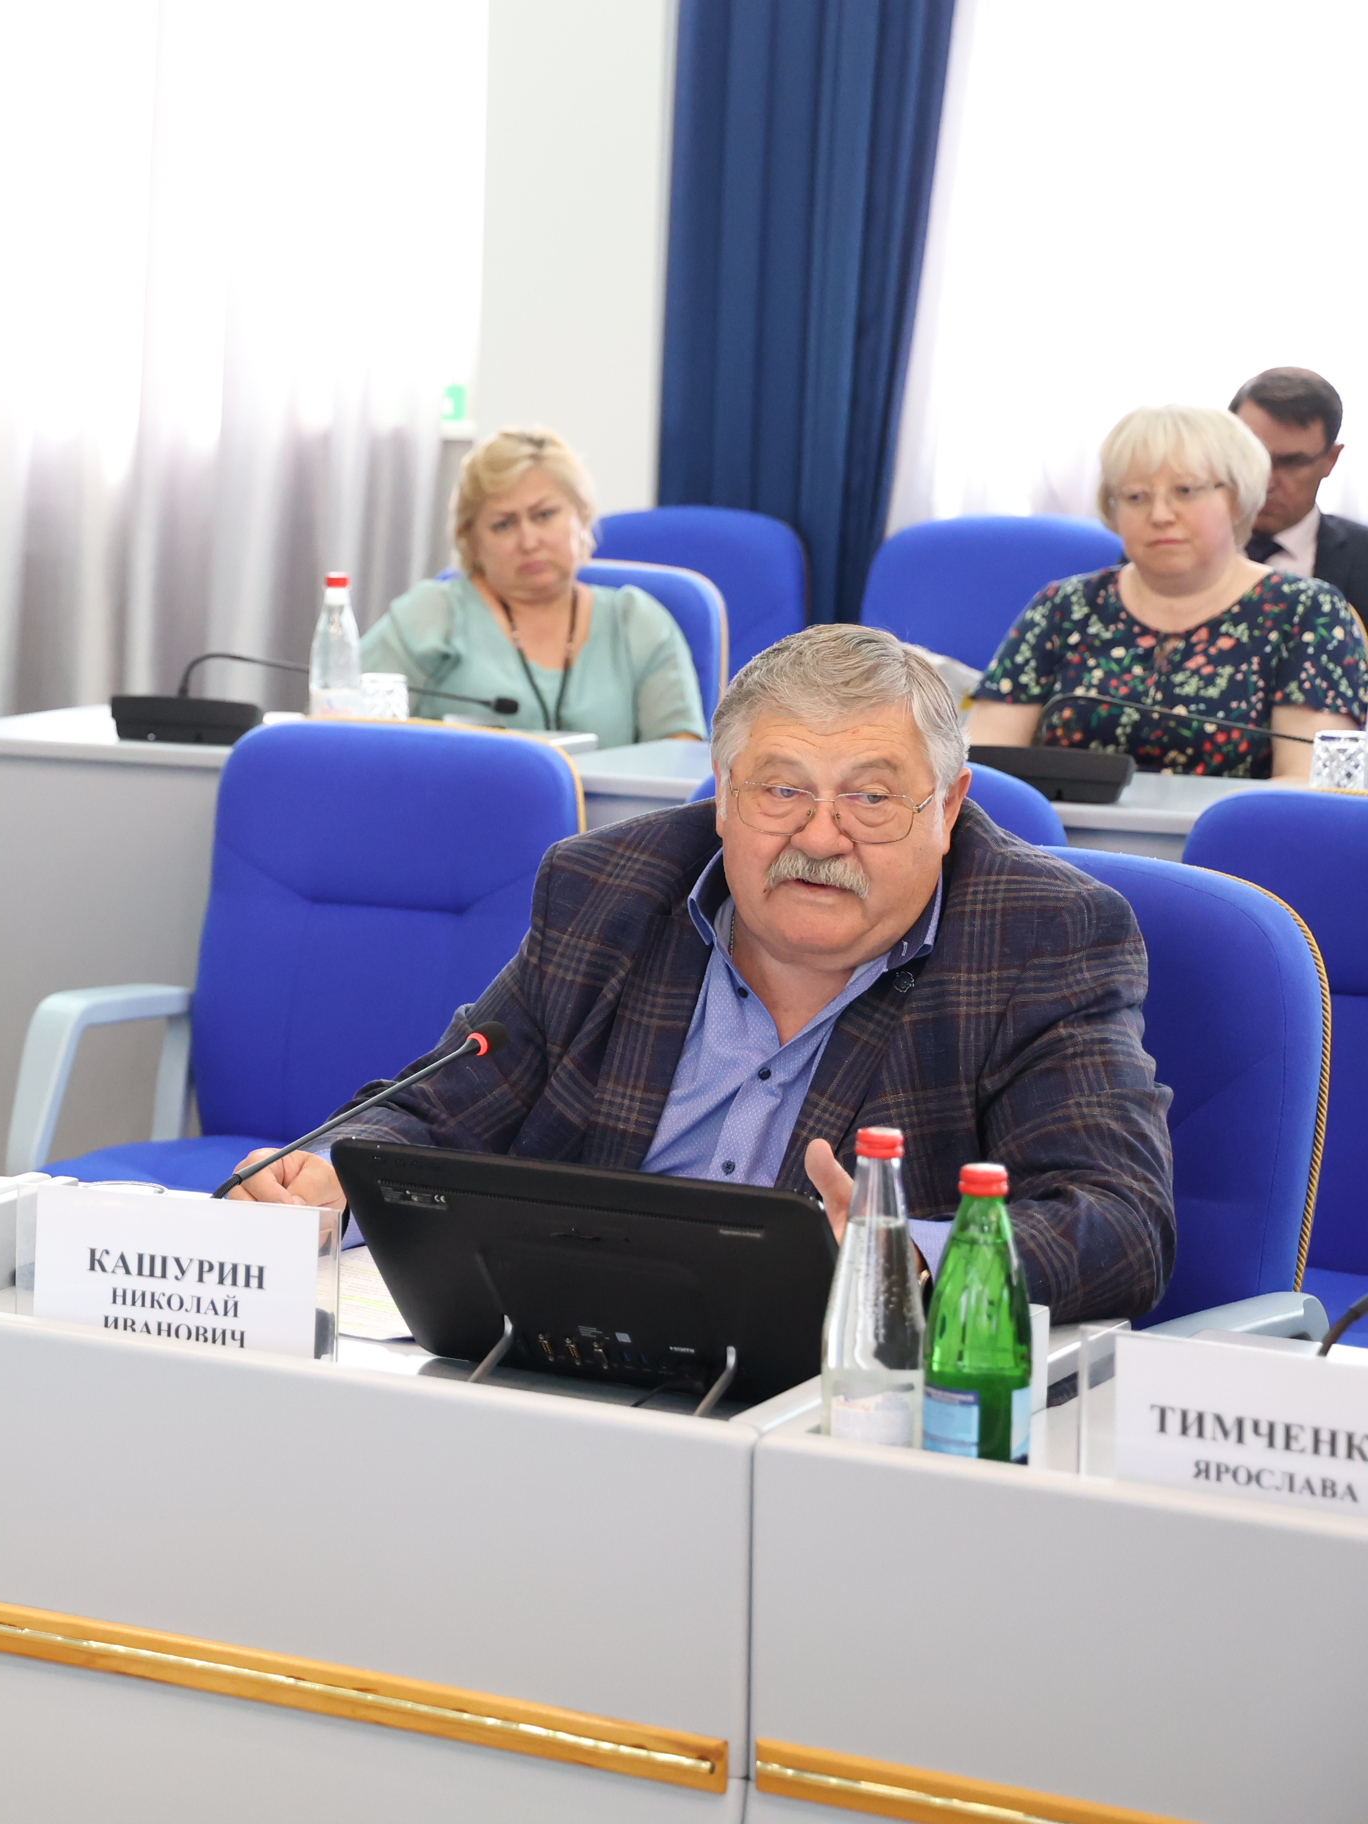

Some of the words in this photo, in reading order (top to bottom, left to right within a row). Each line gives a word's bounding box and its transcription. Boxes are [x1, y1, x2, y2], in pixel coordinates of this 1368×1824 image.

[87, 1247, 266, 1290] КАШУРИН
[111, 1287, 240, 1318] НИКОЛАЙ
[103, 1314, 246, 1348] ИВАНОВИЧ
[1150, 1404, 1368, 1463] ТИМЧЕНК
[1192, 1459, 1359, 1503] ЯРОСЛАВА
